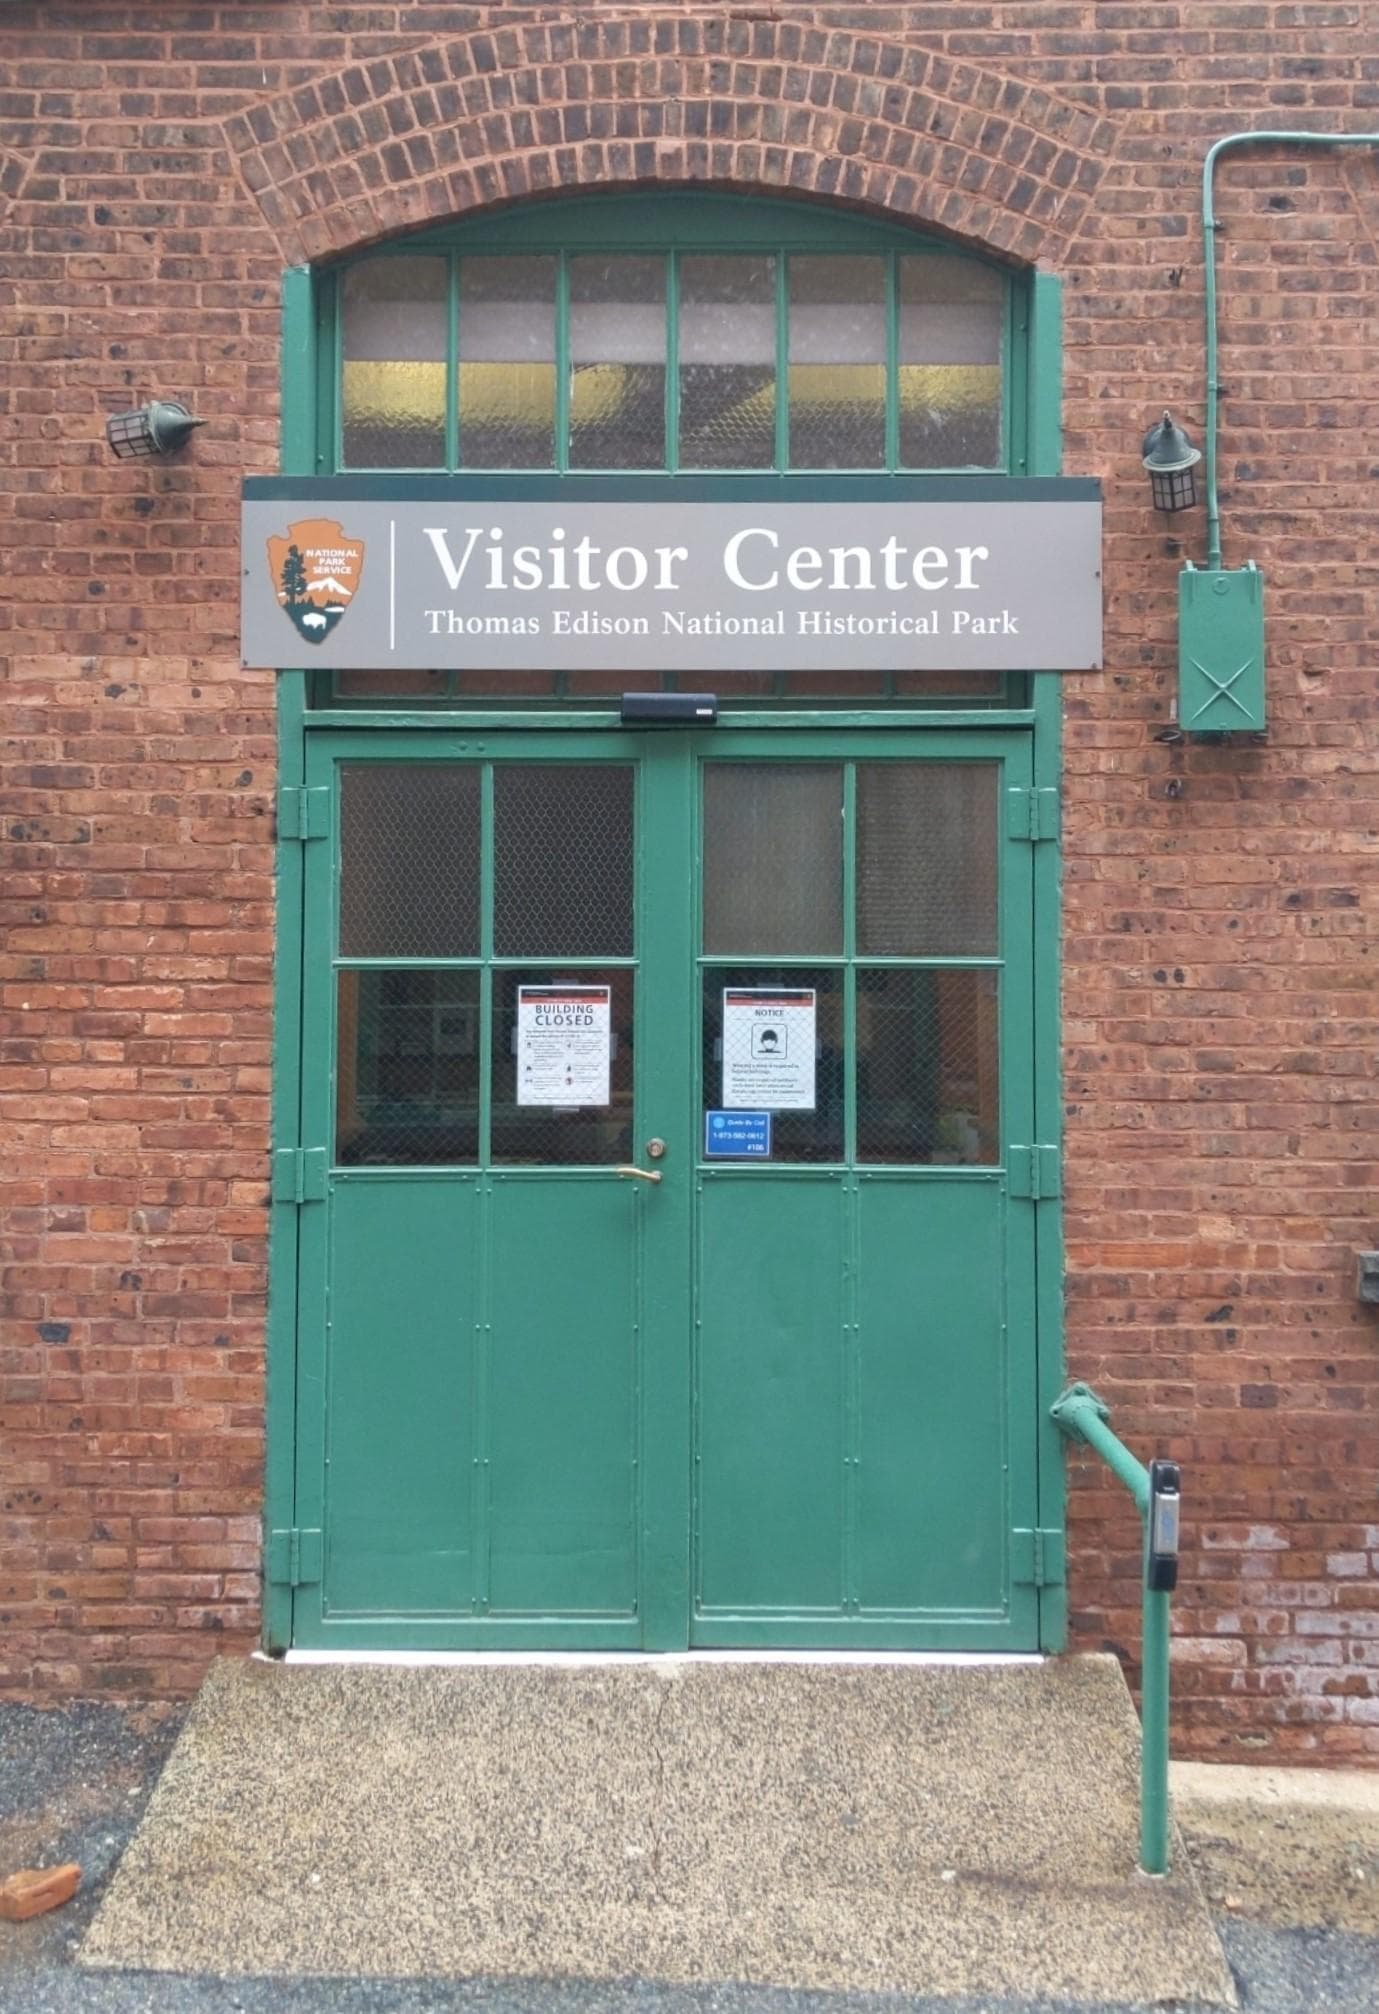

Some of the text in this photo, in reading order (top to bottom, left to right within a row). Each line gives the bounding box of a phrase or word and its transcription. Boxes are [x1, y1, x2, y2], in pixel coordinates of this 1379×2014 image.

[306, 549, 358, 557] NATIONAL
[423, 526, 990, 591] Visitor Center
[313, 566, 352, 574] SERVICE
[425, 609, 1019, 635] Thomas Edison National Historical Park
[535, 1004, 593, 1014] BUILDING
[535, 1014, 593, 1026] CLOSED
